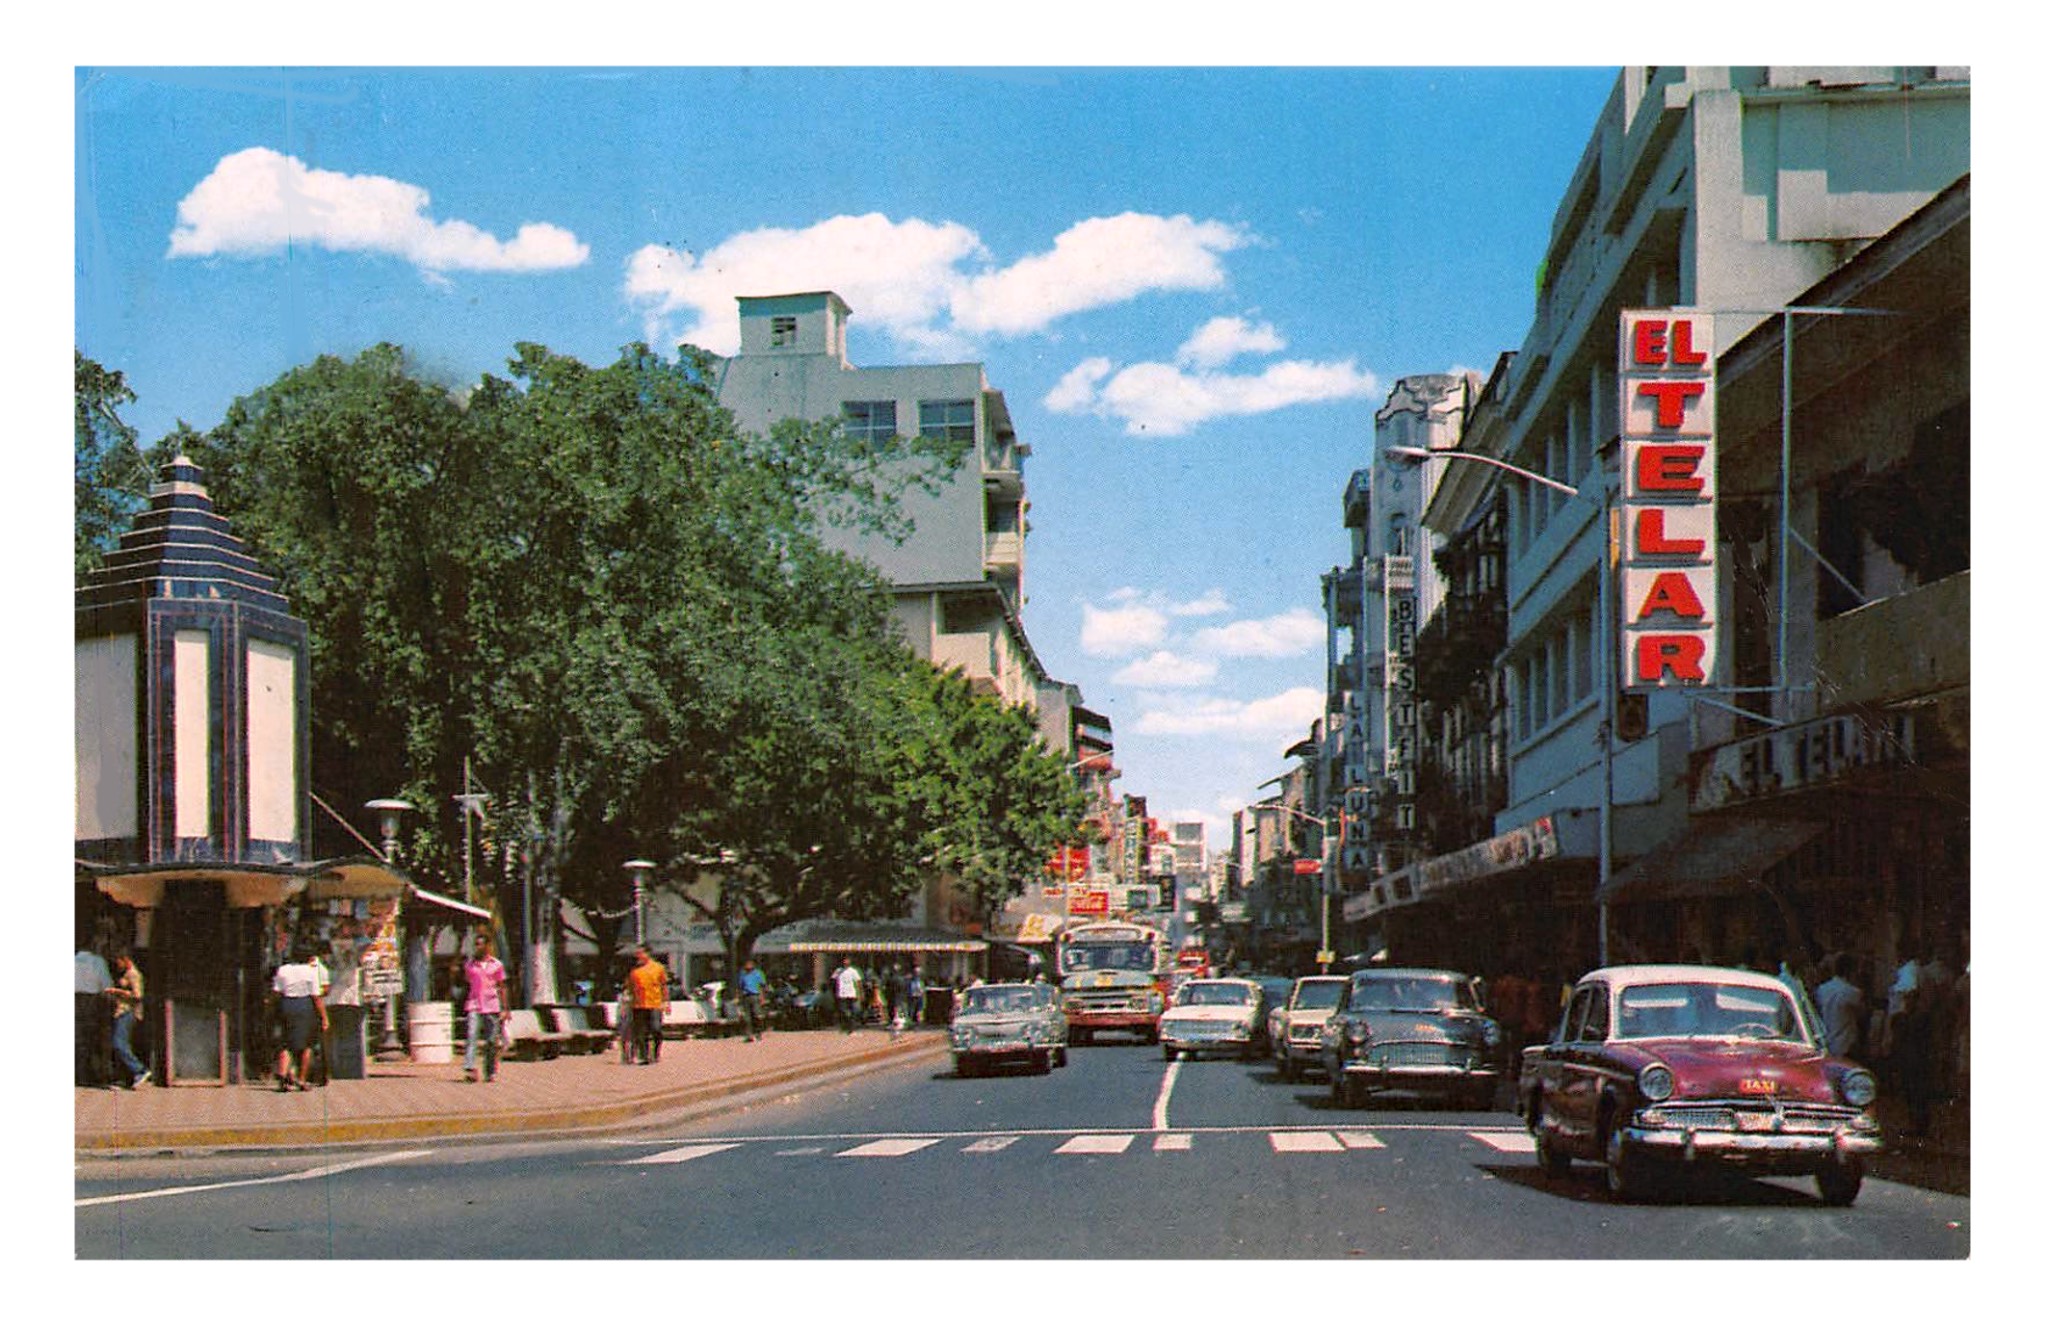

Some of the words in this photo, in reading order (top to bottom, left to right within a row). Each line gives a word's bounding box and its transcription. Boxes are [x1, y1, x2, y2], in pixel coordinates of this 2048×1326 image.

[1633, 319, 1707, 366] EL
[1636, 380, 1707, 682] TELAR
[1745, 1078, 1776, 1091] TAXI
